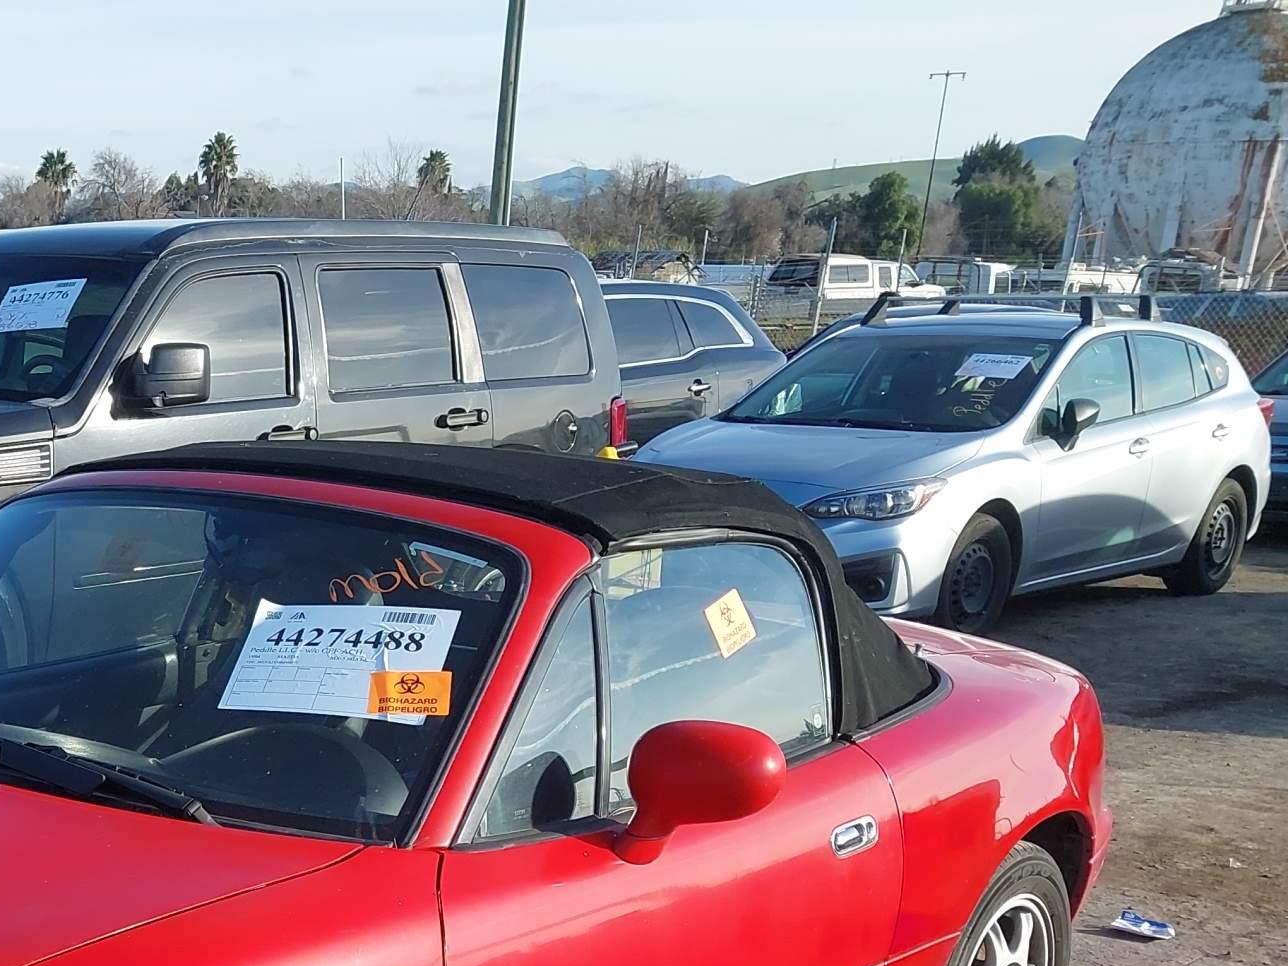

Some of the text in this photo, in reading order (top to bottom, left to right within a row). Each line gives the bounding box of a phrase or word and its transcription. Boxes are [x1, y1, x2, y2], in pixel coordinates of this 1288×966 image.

[9, 290, 70, 305] 44274776
[266, 627, 426, 652] 44274488
[378, 697, 438, 706] BIOHAZARD
[377, 705, 438, 714] BIOPELIGRO
